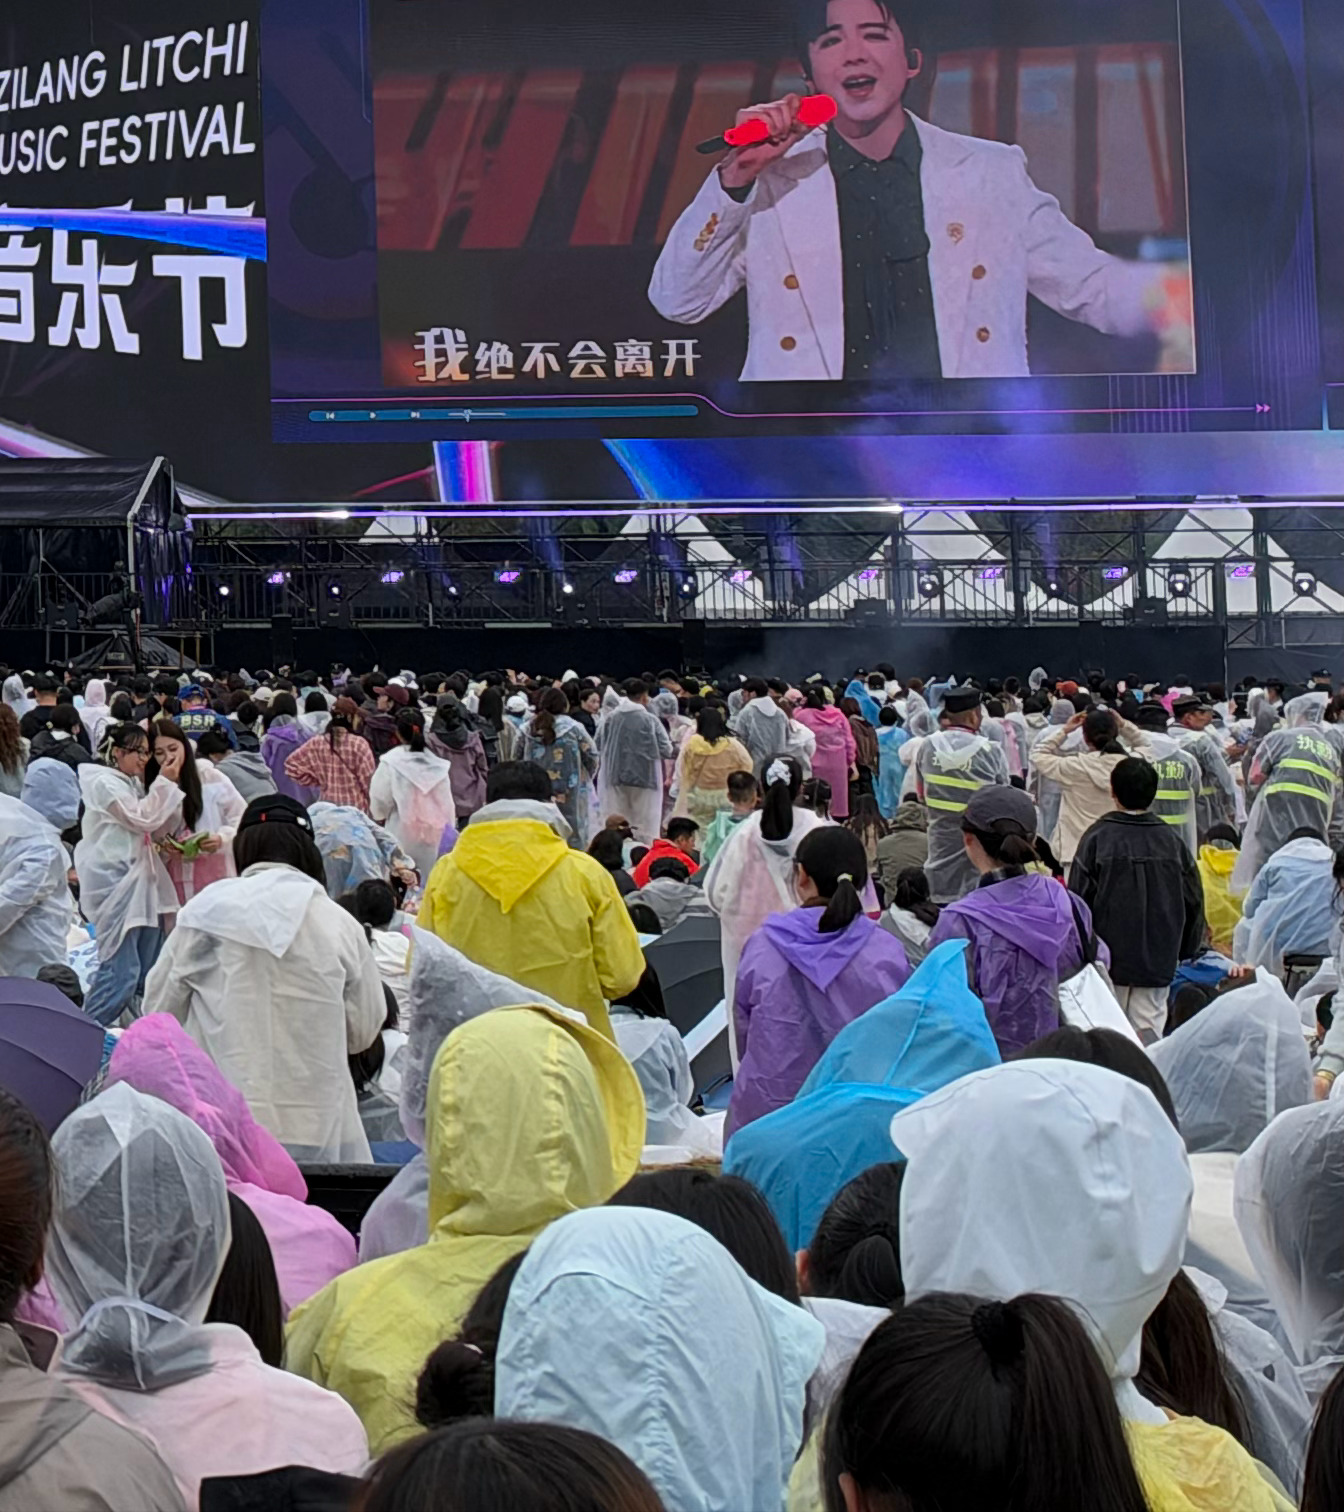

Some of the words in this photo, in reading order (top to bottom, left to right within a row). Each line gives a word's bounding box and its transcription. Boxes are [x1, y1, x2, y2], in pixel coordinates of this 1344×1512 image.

[119, 20, 250, 92] LITCHI
[79, 101, 256, 168] FESTIVAL
[413, 327, 702, 382] 我绝不会离开
[1296, 734, 1333, 761] 执勤
